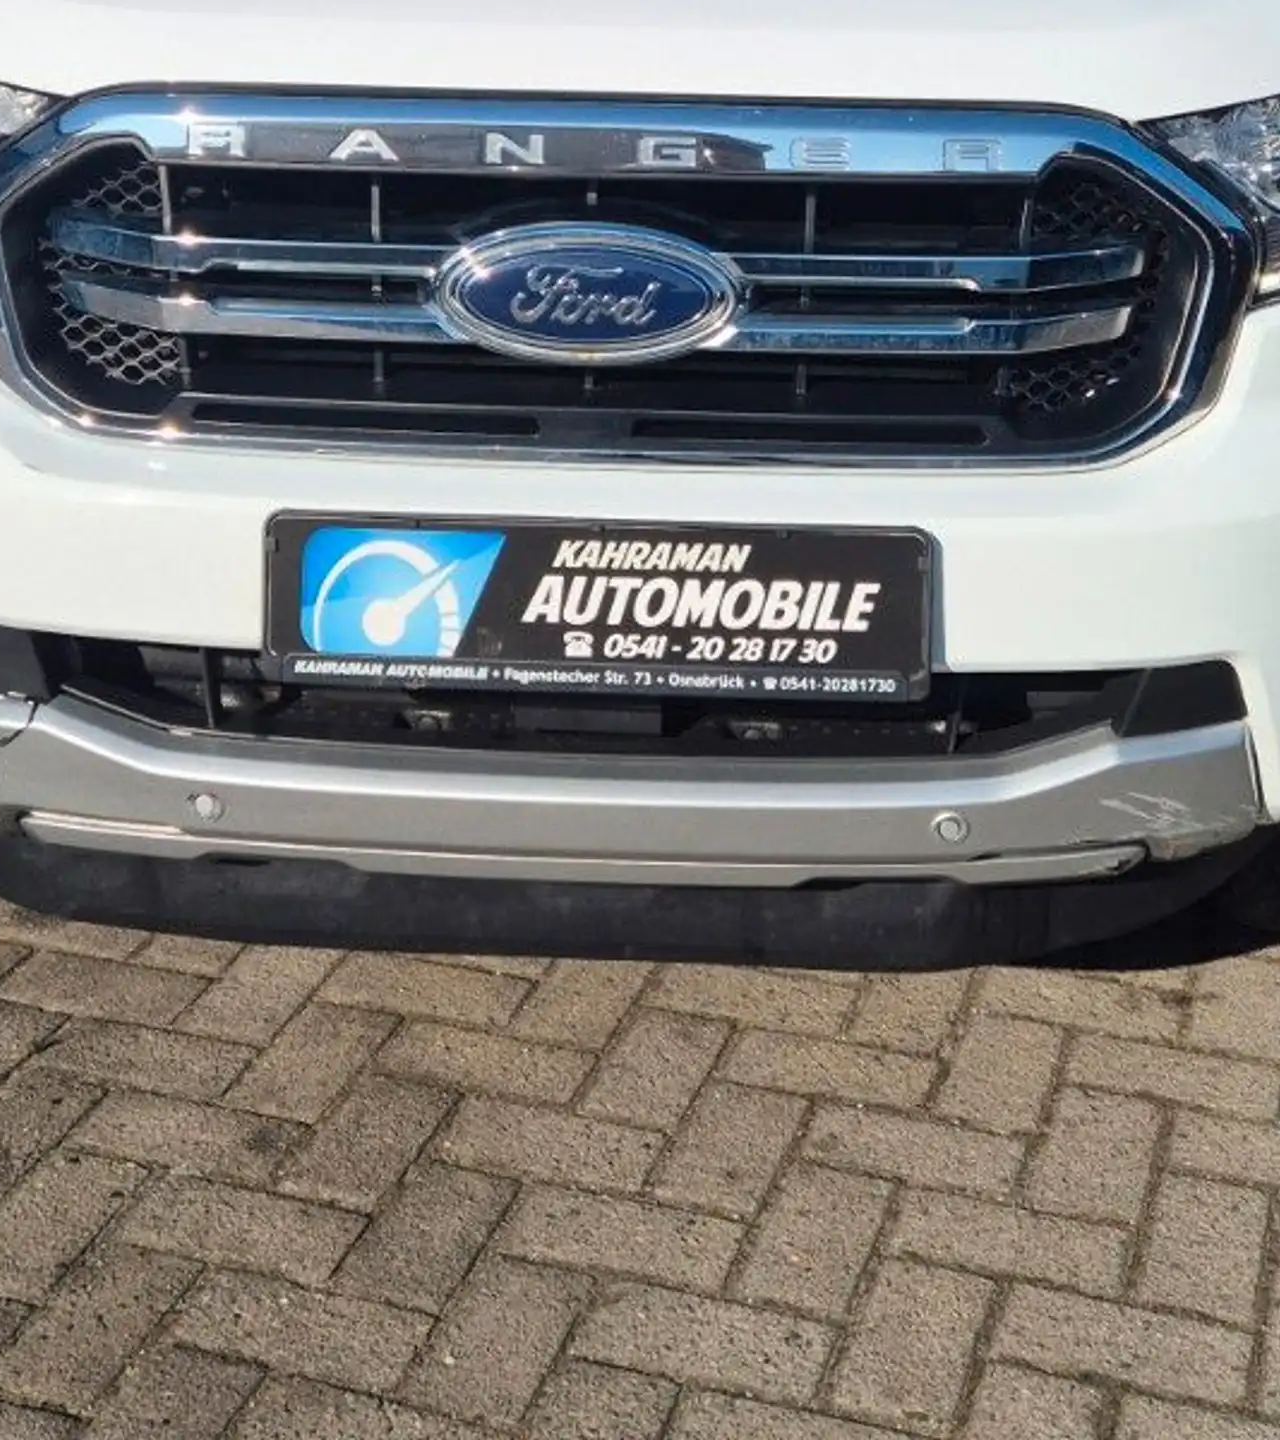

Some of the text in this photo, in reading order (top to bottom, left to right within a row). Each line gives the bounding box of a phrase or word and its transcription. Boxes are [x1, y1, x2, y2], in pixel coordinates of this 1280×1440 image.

[186, 121, 1004, 173] RANGER
[510, 262, 662, 325] Ford
[552, 539, 752, 574] KAHRAMAN
[521, 574, 881, 633] AUTOMOBILE
[603, 632, 666, 659] 0541
[685, 635, 725, 661] 20
[727, 636, 765, 662] 28
[767, 637, 798, 662] 17
[797, 638, 839, 664] 30
[294, 659, 384, 678] KAHRAMAN
[385, 662, 489, 681] AUTOMOBILE
[604, 669, 629, 685] Str.
[634, 671, 652, 686] 73
[668, 672, 745, 691] Osnabrück
